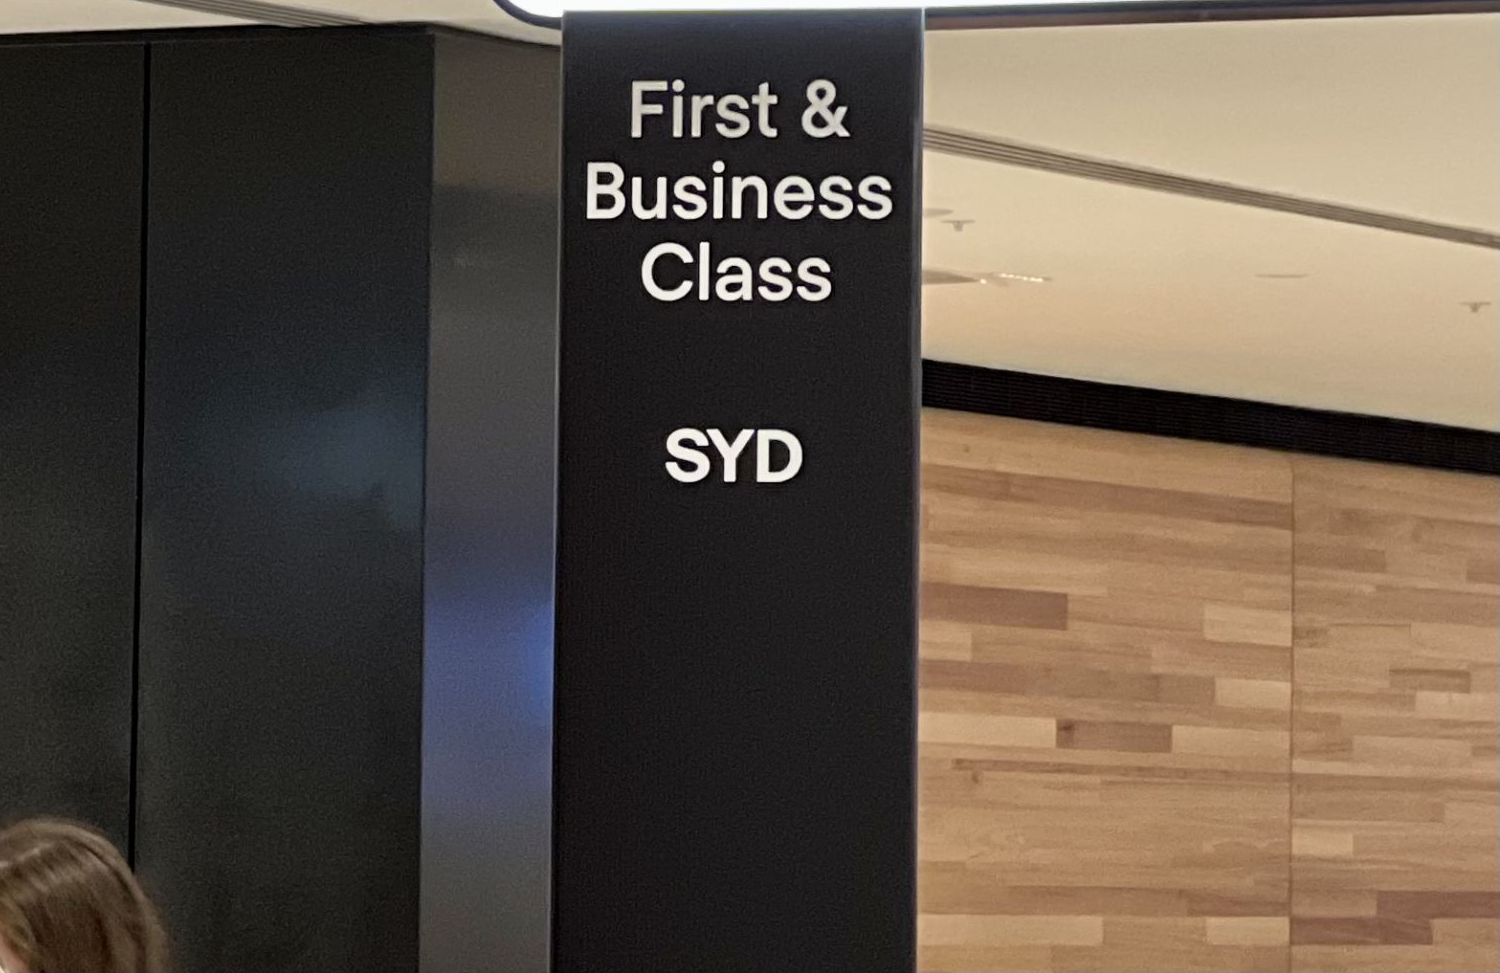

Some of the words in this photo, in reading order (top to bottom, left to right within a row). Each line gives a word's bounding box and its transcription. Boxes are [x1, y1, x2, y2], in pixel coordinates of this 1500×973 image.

[631, 79, 778, 138] First
[801, 79, 851, 138] &
[586, 160, 893, 220] Business
[641, 241, 832, 302] Class
[665, 427, 803, 483] SYD
